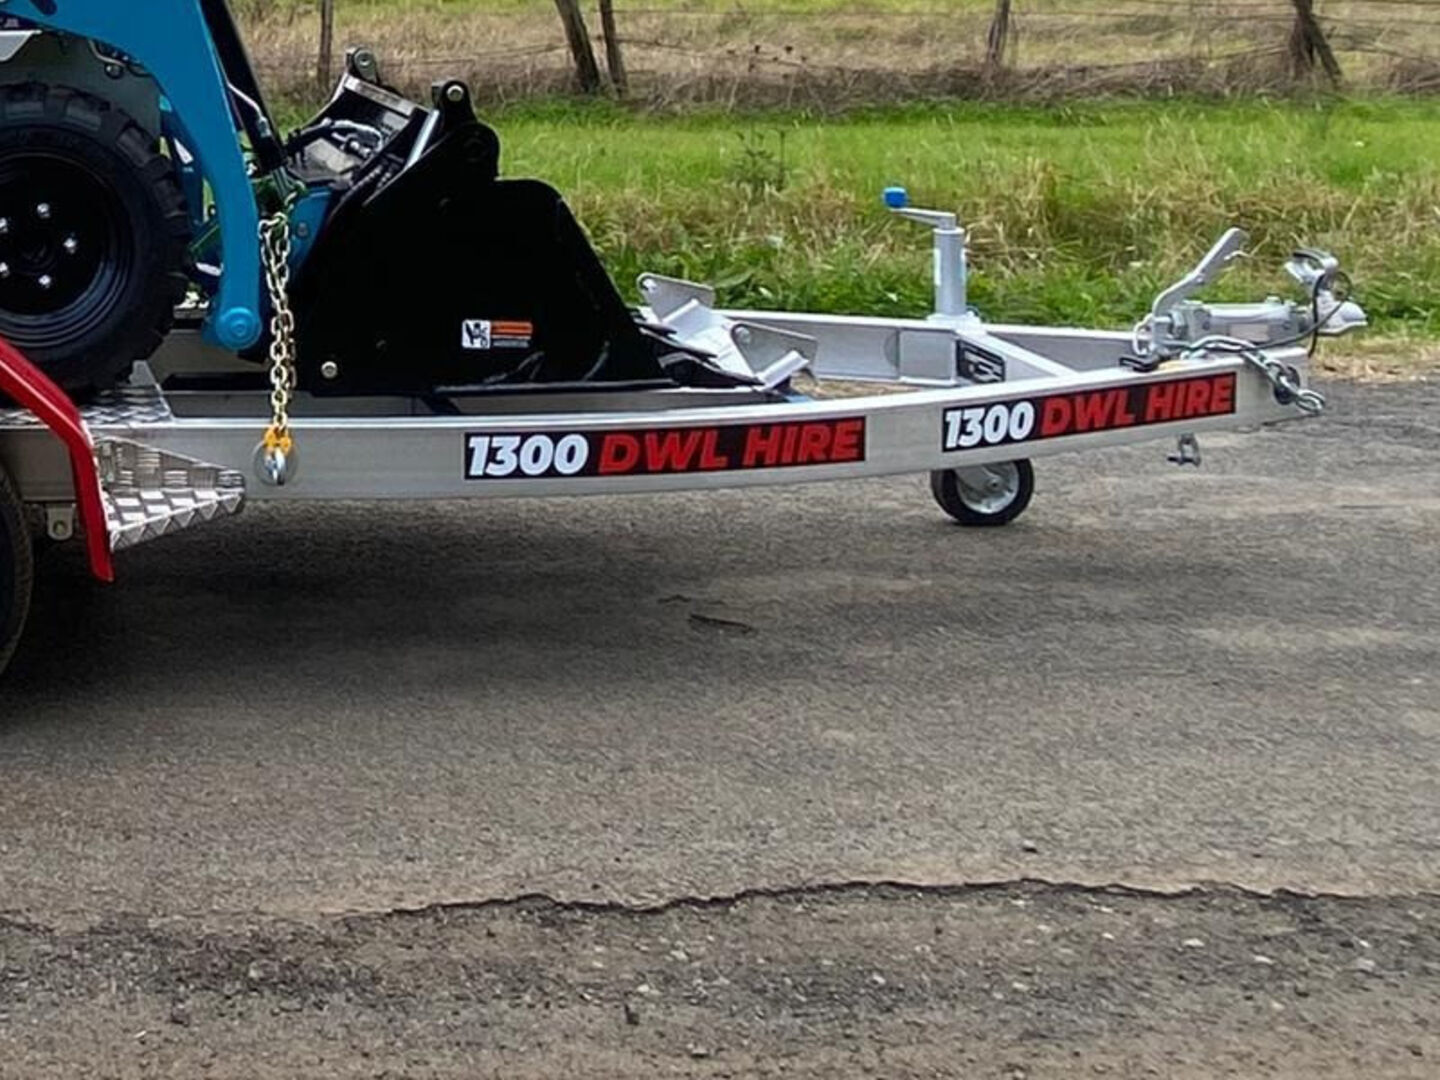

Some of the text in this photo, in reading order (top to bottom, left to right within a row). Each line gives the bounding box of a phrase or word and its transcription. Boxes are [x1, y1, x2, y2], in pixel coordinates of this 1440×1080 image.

[944, 375, 1236, 449] 1300 DWL HIRE
[468, 421, 861, 476] 1300 DWL HIRE
